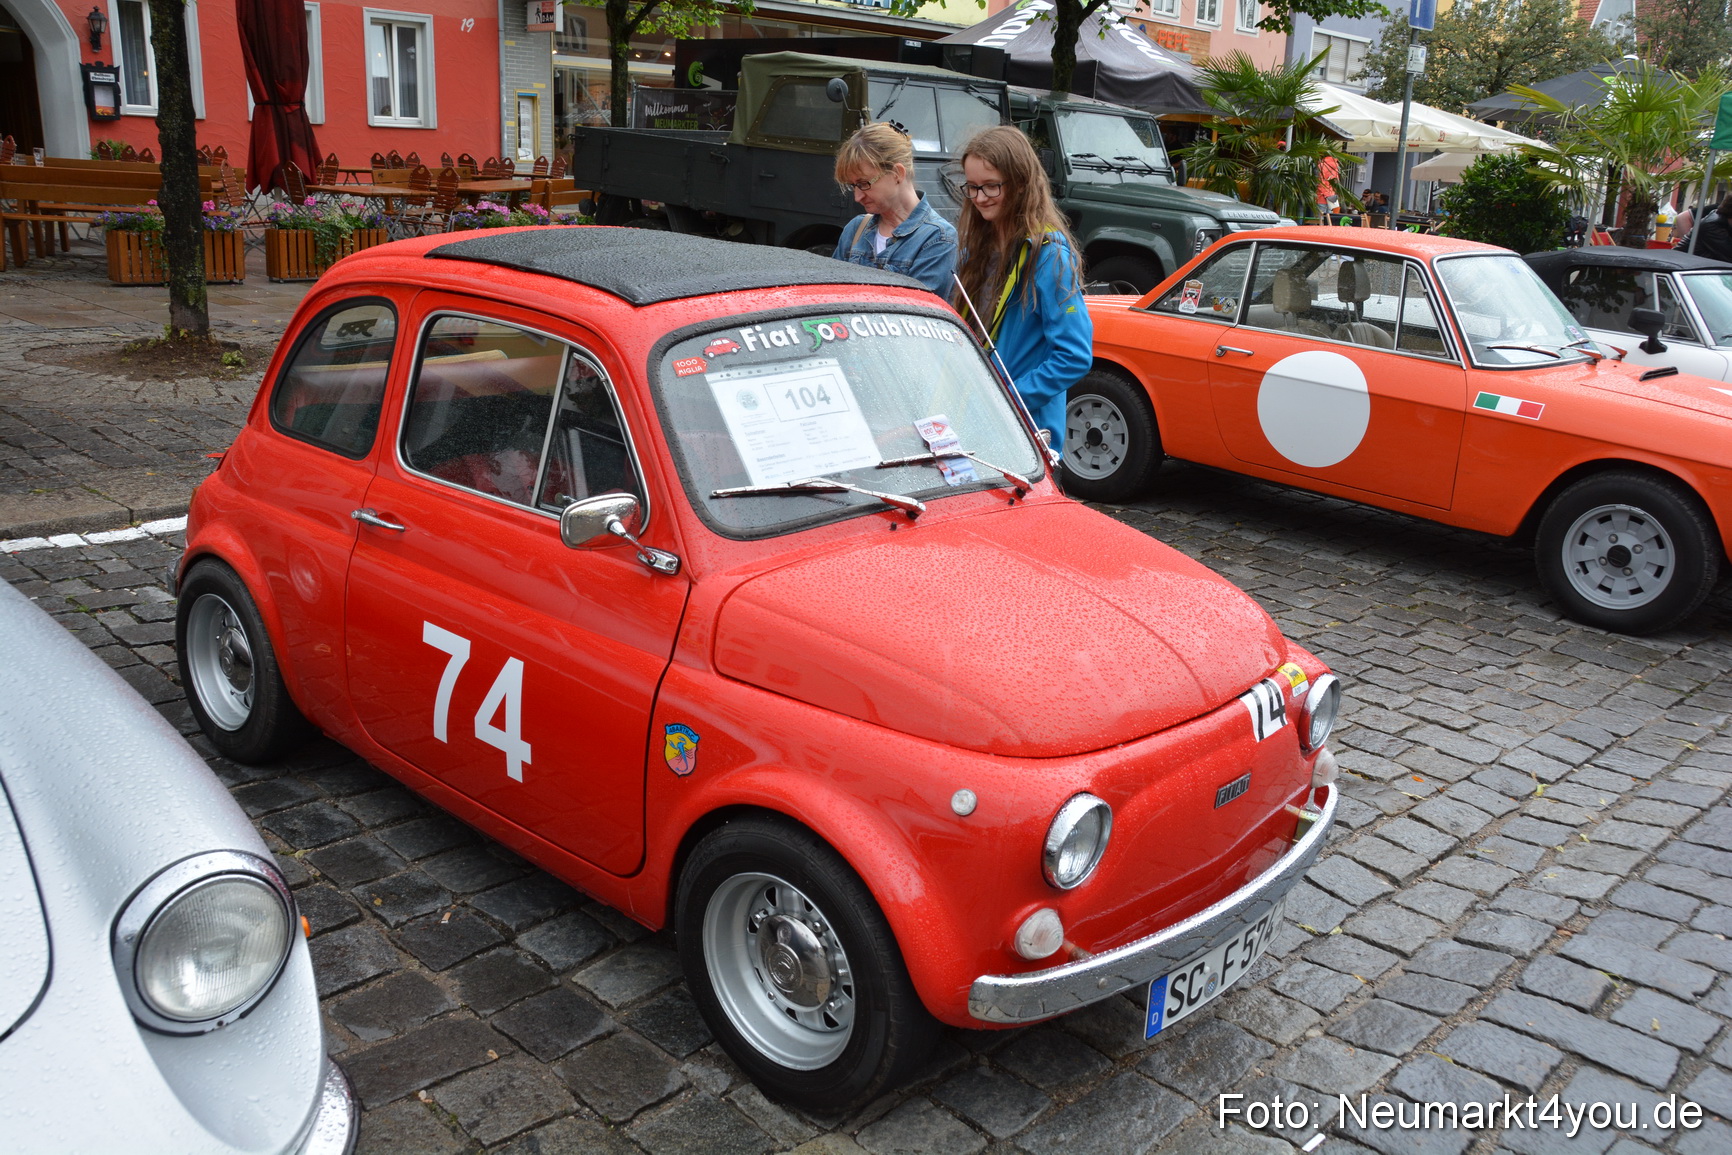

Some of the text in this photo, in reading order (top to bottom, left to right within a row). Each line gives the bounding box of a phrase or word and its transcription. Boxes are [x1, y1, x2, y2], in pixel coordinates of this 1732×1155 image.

[461, 18, 475, 33] 19
[1158, 29, 1190, 51] PEPE
[645, 102, 689, 117] Willkommen
[655, 118, 699, 130] NEUMARKTER
[739, 315, 956, 352] Fiat 500 Club Italia
[676, 358, 698, 367] 1000
[678, 365, 703, 375] MIGLIA
[785, 384, 831, 410] 104
[422, 620, 532, 783] 74
[1218, 776, 1250, 806] FIAT
[1166, 961, 1206, 1019] SC
[1220, 938, 1240, 986] F
[1240, 903, 1278, 970] 574
[1151, 1011, 1159, 1026] D
